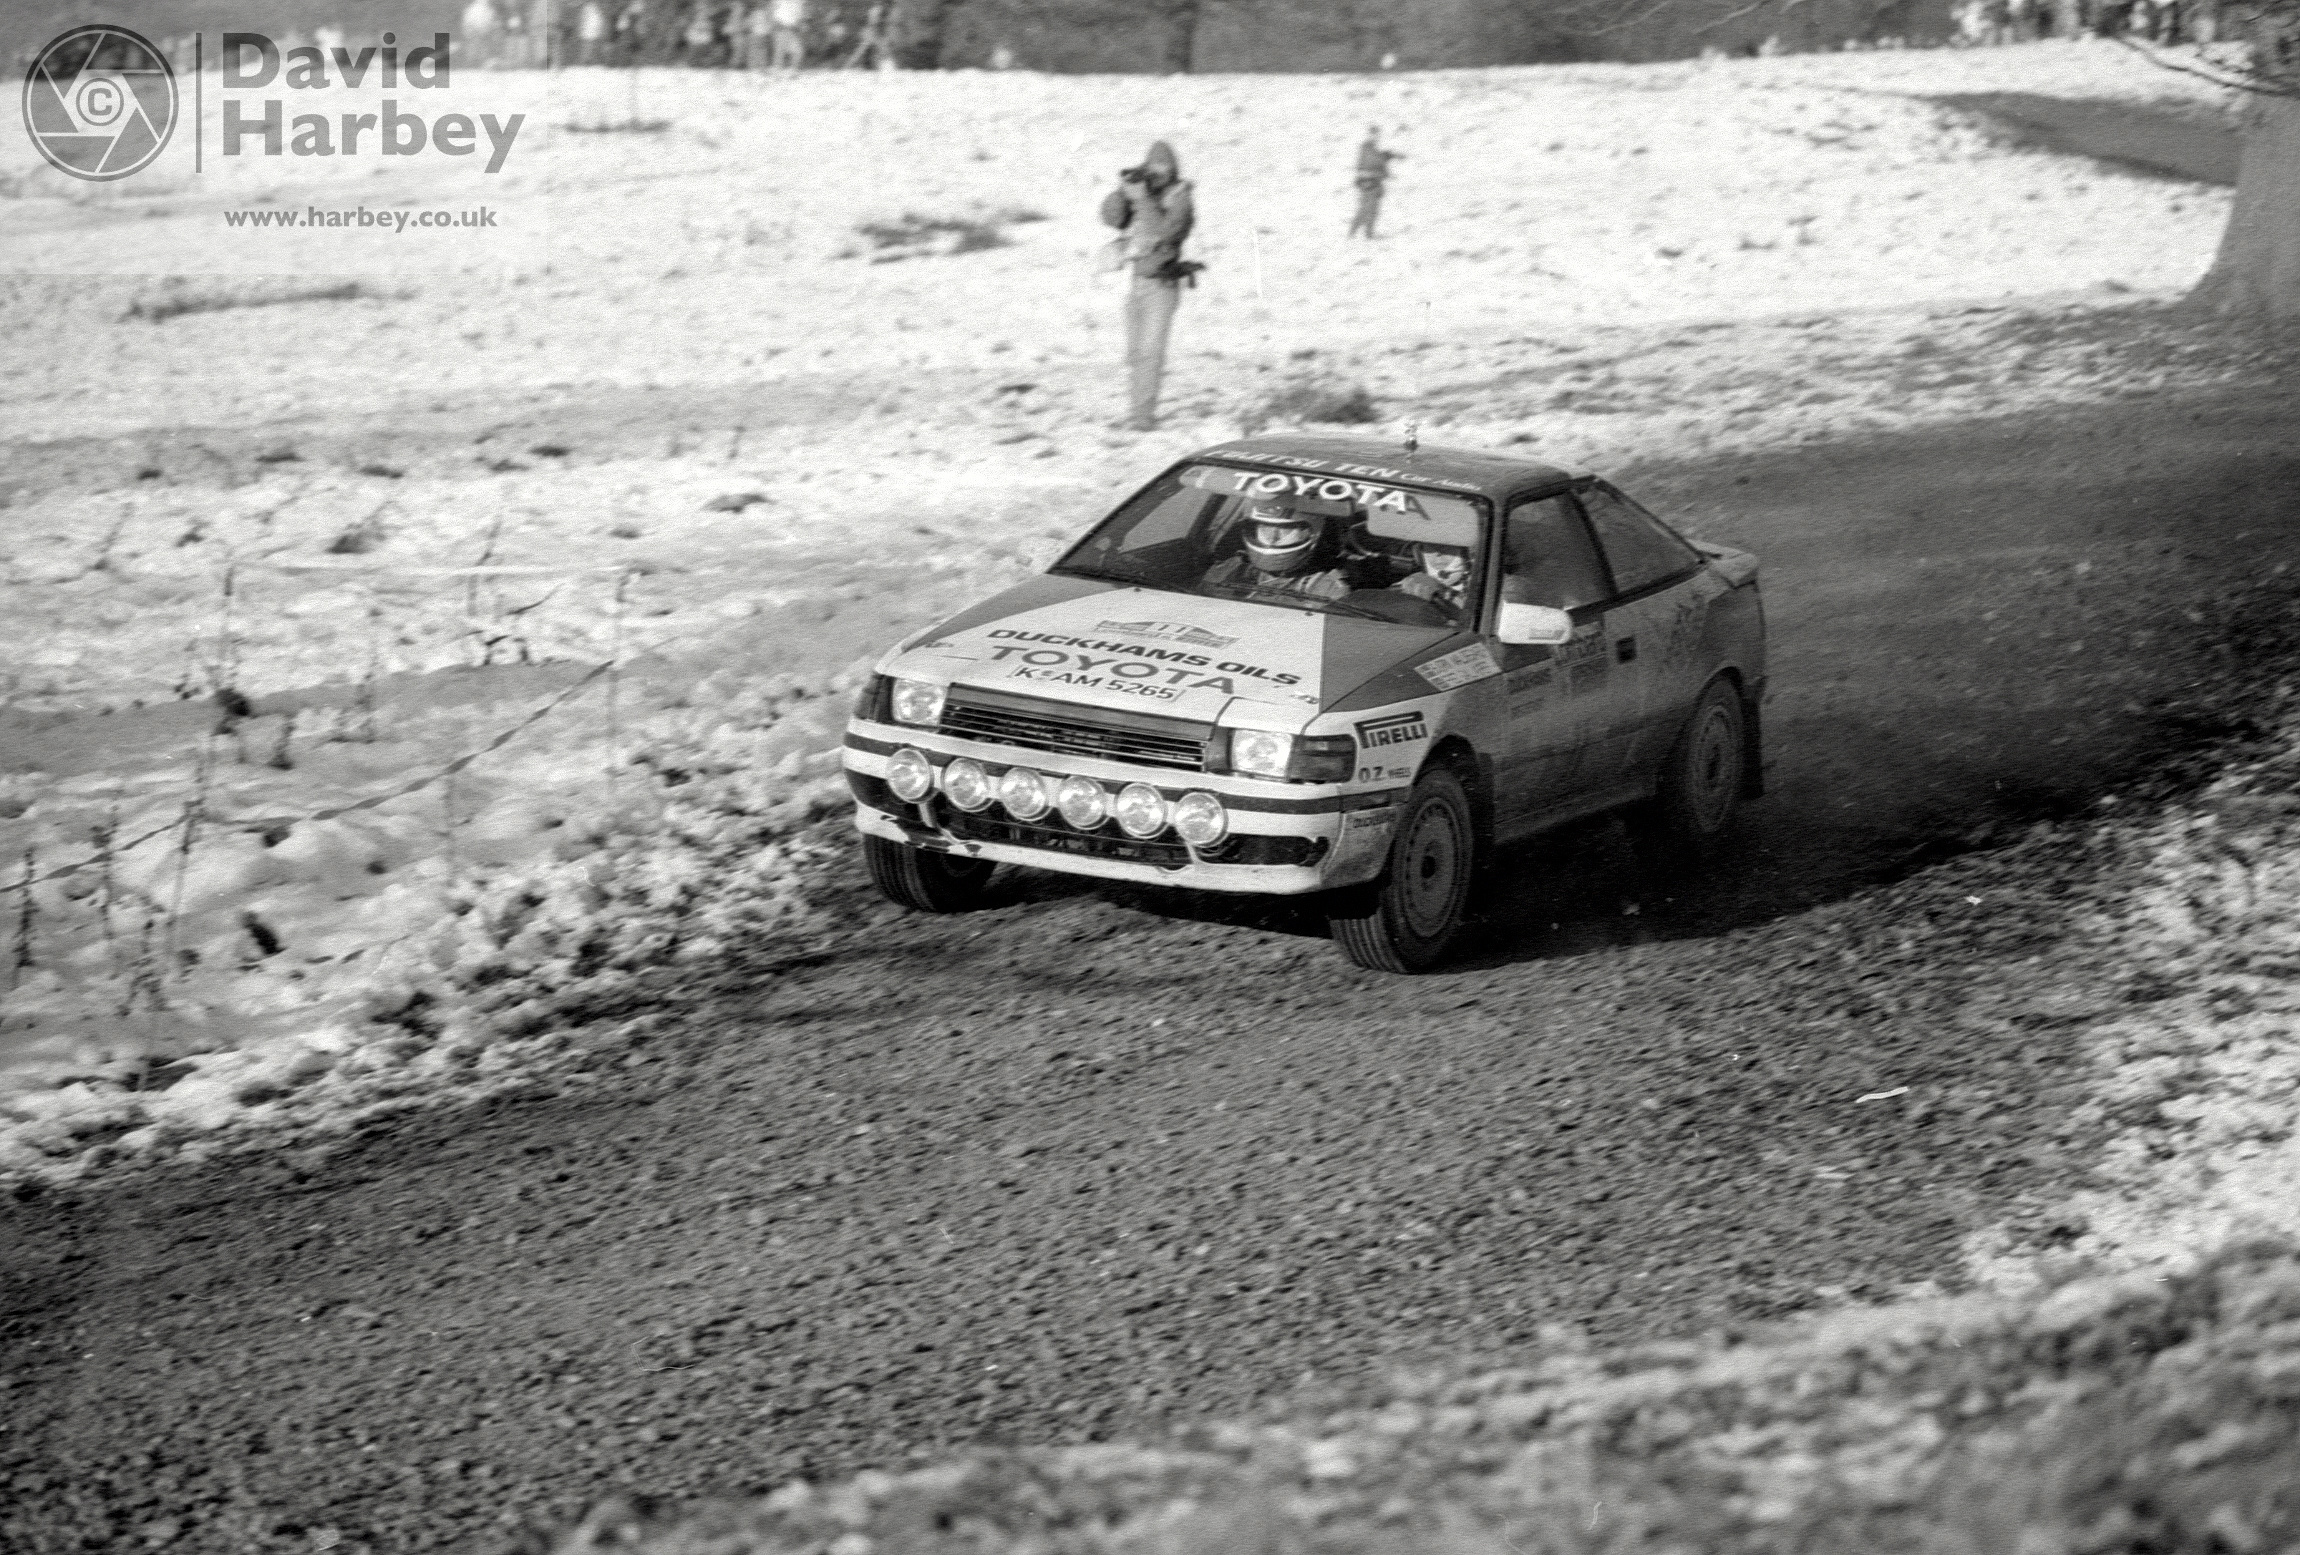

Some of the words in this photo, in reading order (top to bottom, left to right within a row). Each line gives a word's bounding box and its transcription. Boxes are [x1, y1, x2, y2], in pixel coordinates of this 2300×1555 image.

[1334, 463, 1401, 478] TEN
[1233, 471, 1407, 514] TOYOTA
[986, 629, 1212, 667] DUCKHAMS
[1215, 661, 1301, 685] OILS
[991, 645, 1236, 695] TOYOTA
[1106, 679, 1177, 700] 5265
[1353, 711, 1428, 749] PIRELLI
